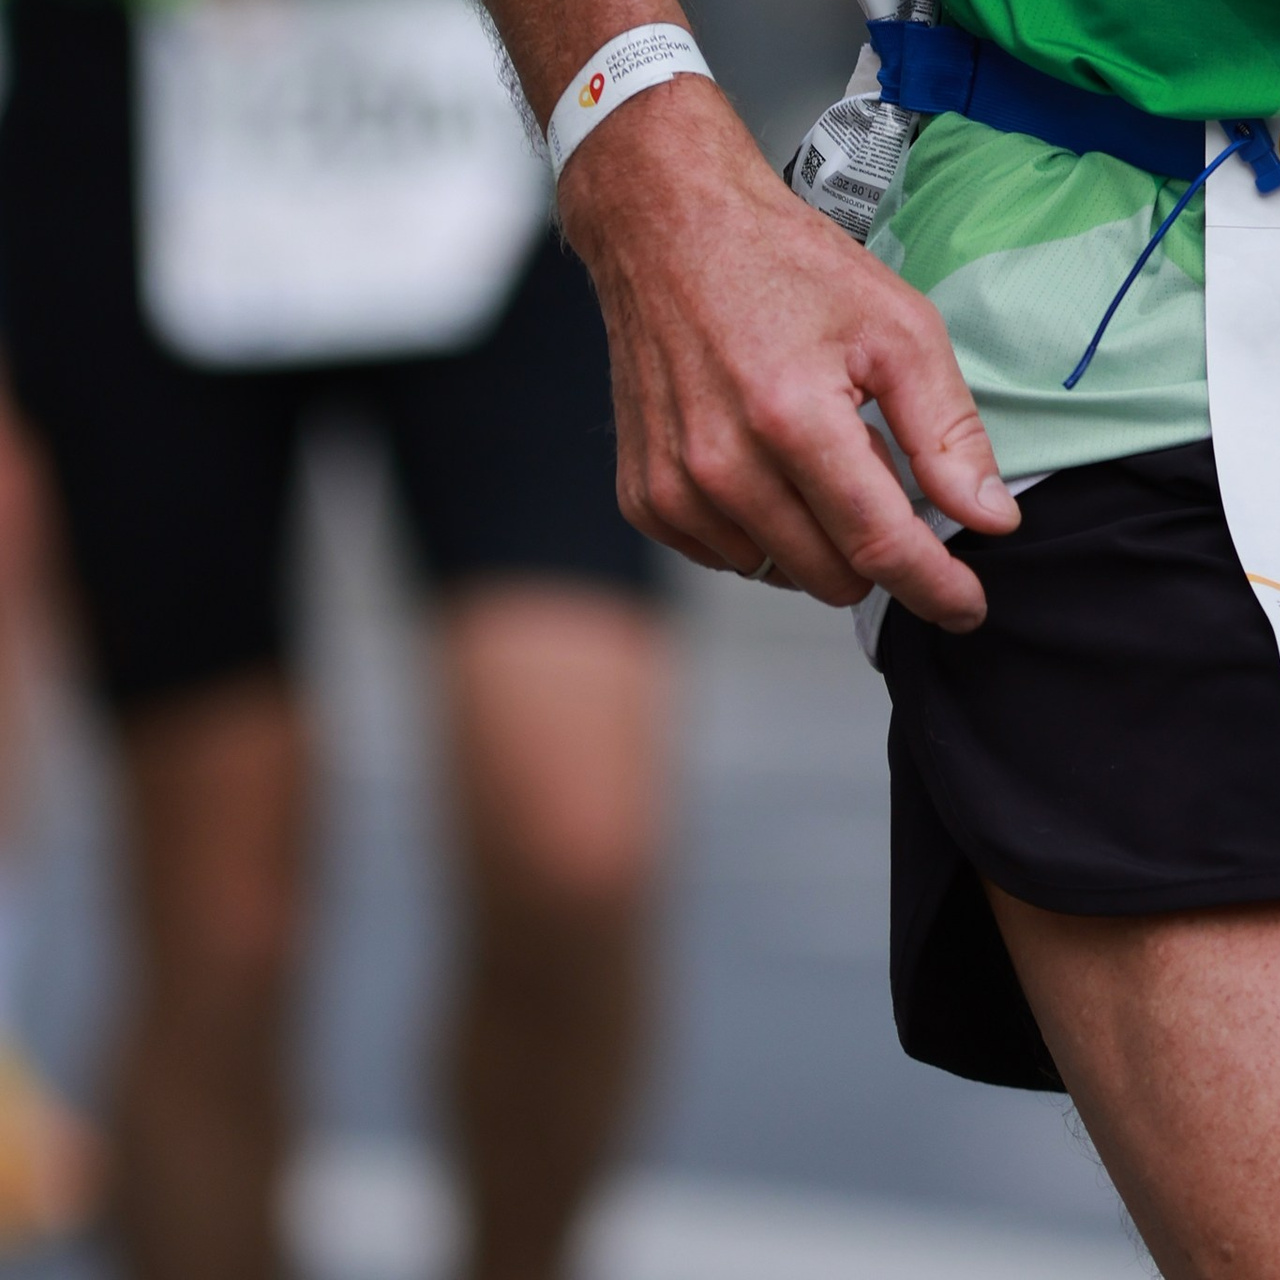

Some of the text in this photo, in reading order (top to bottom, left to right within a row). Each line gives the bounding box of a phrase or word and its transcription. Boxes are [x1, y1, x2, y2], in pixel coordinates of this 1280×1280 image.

[605, 34, 667, 66] СБЕРПРАЙМ
[608, 42, 691, 74] МОСКОВСКИЙ
[612, 52, 674, 84] МАРАФОН
